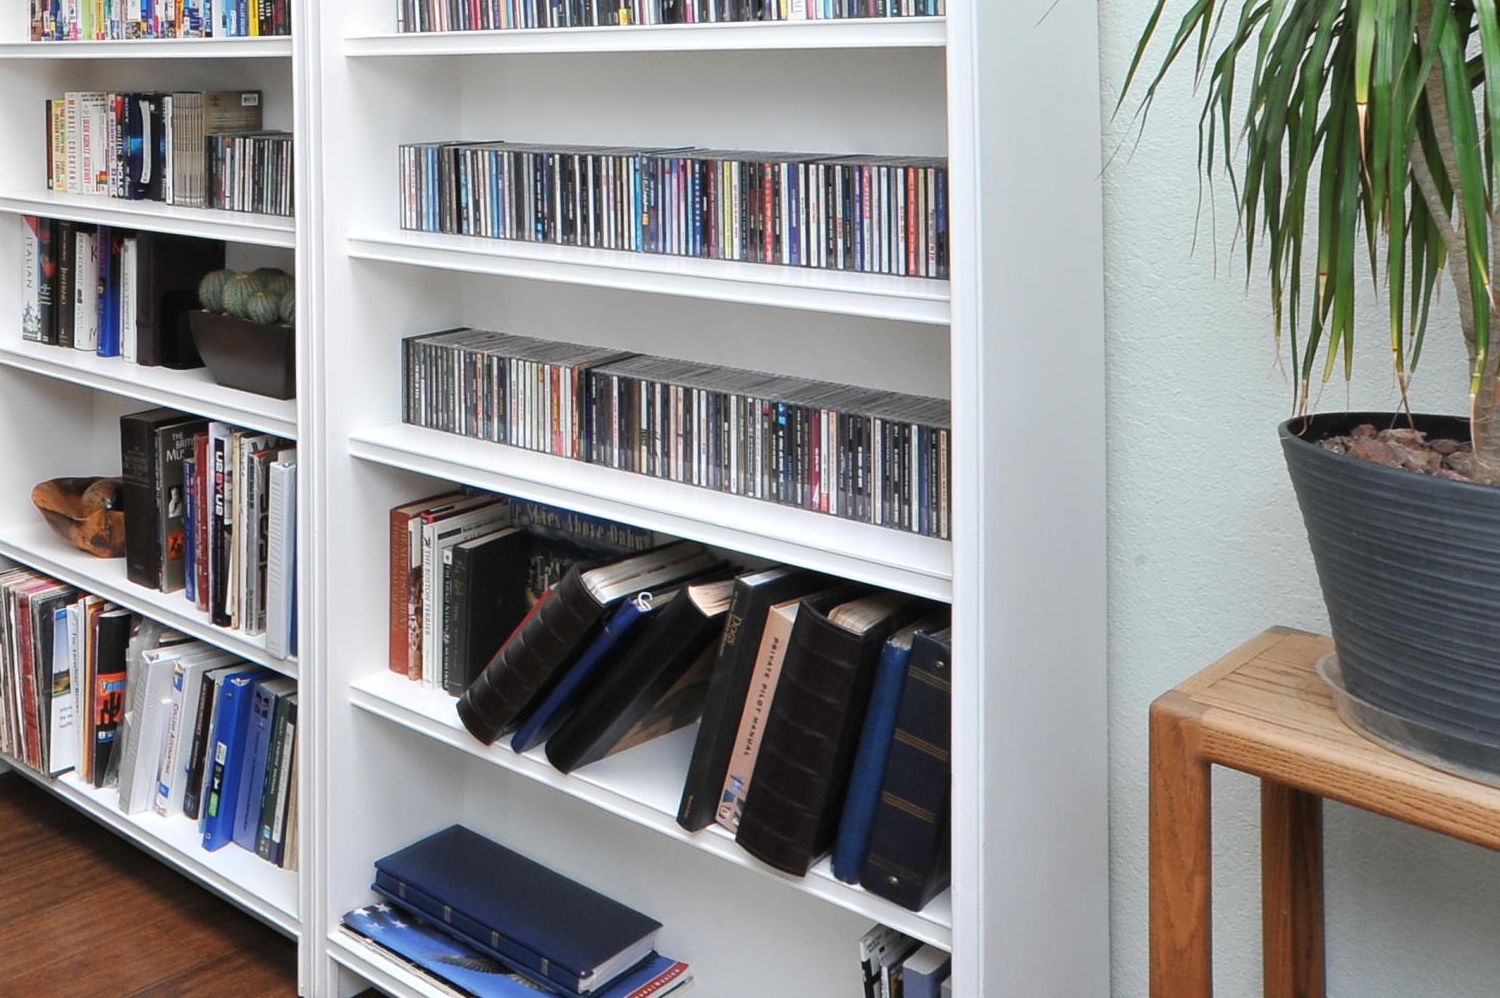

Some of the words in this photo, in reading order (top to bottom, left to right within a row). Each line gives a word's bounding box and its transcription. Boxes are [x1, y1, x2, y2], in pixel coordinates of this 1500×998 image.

[68, 99, 76, 134] MICHAEL
[68, 141, 76, 180] CRICHTON
[172, 432, 183, 441] THE
[175, 436, 195, 449] BRITI
[400, 571, 408, 631] TESTAMENT
[763, 637, 780, 678] PRIVATE
[754, 683, 768, 713] PILOT
[743, 717, 759, 757] MANUAL
